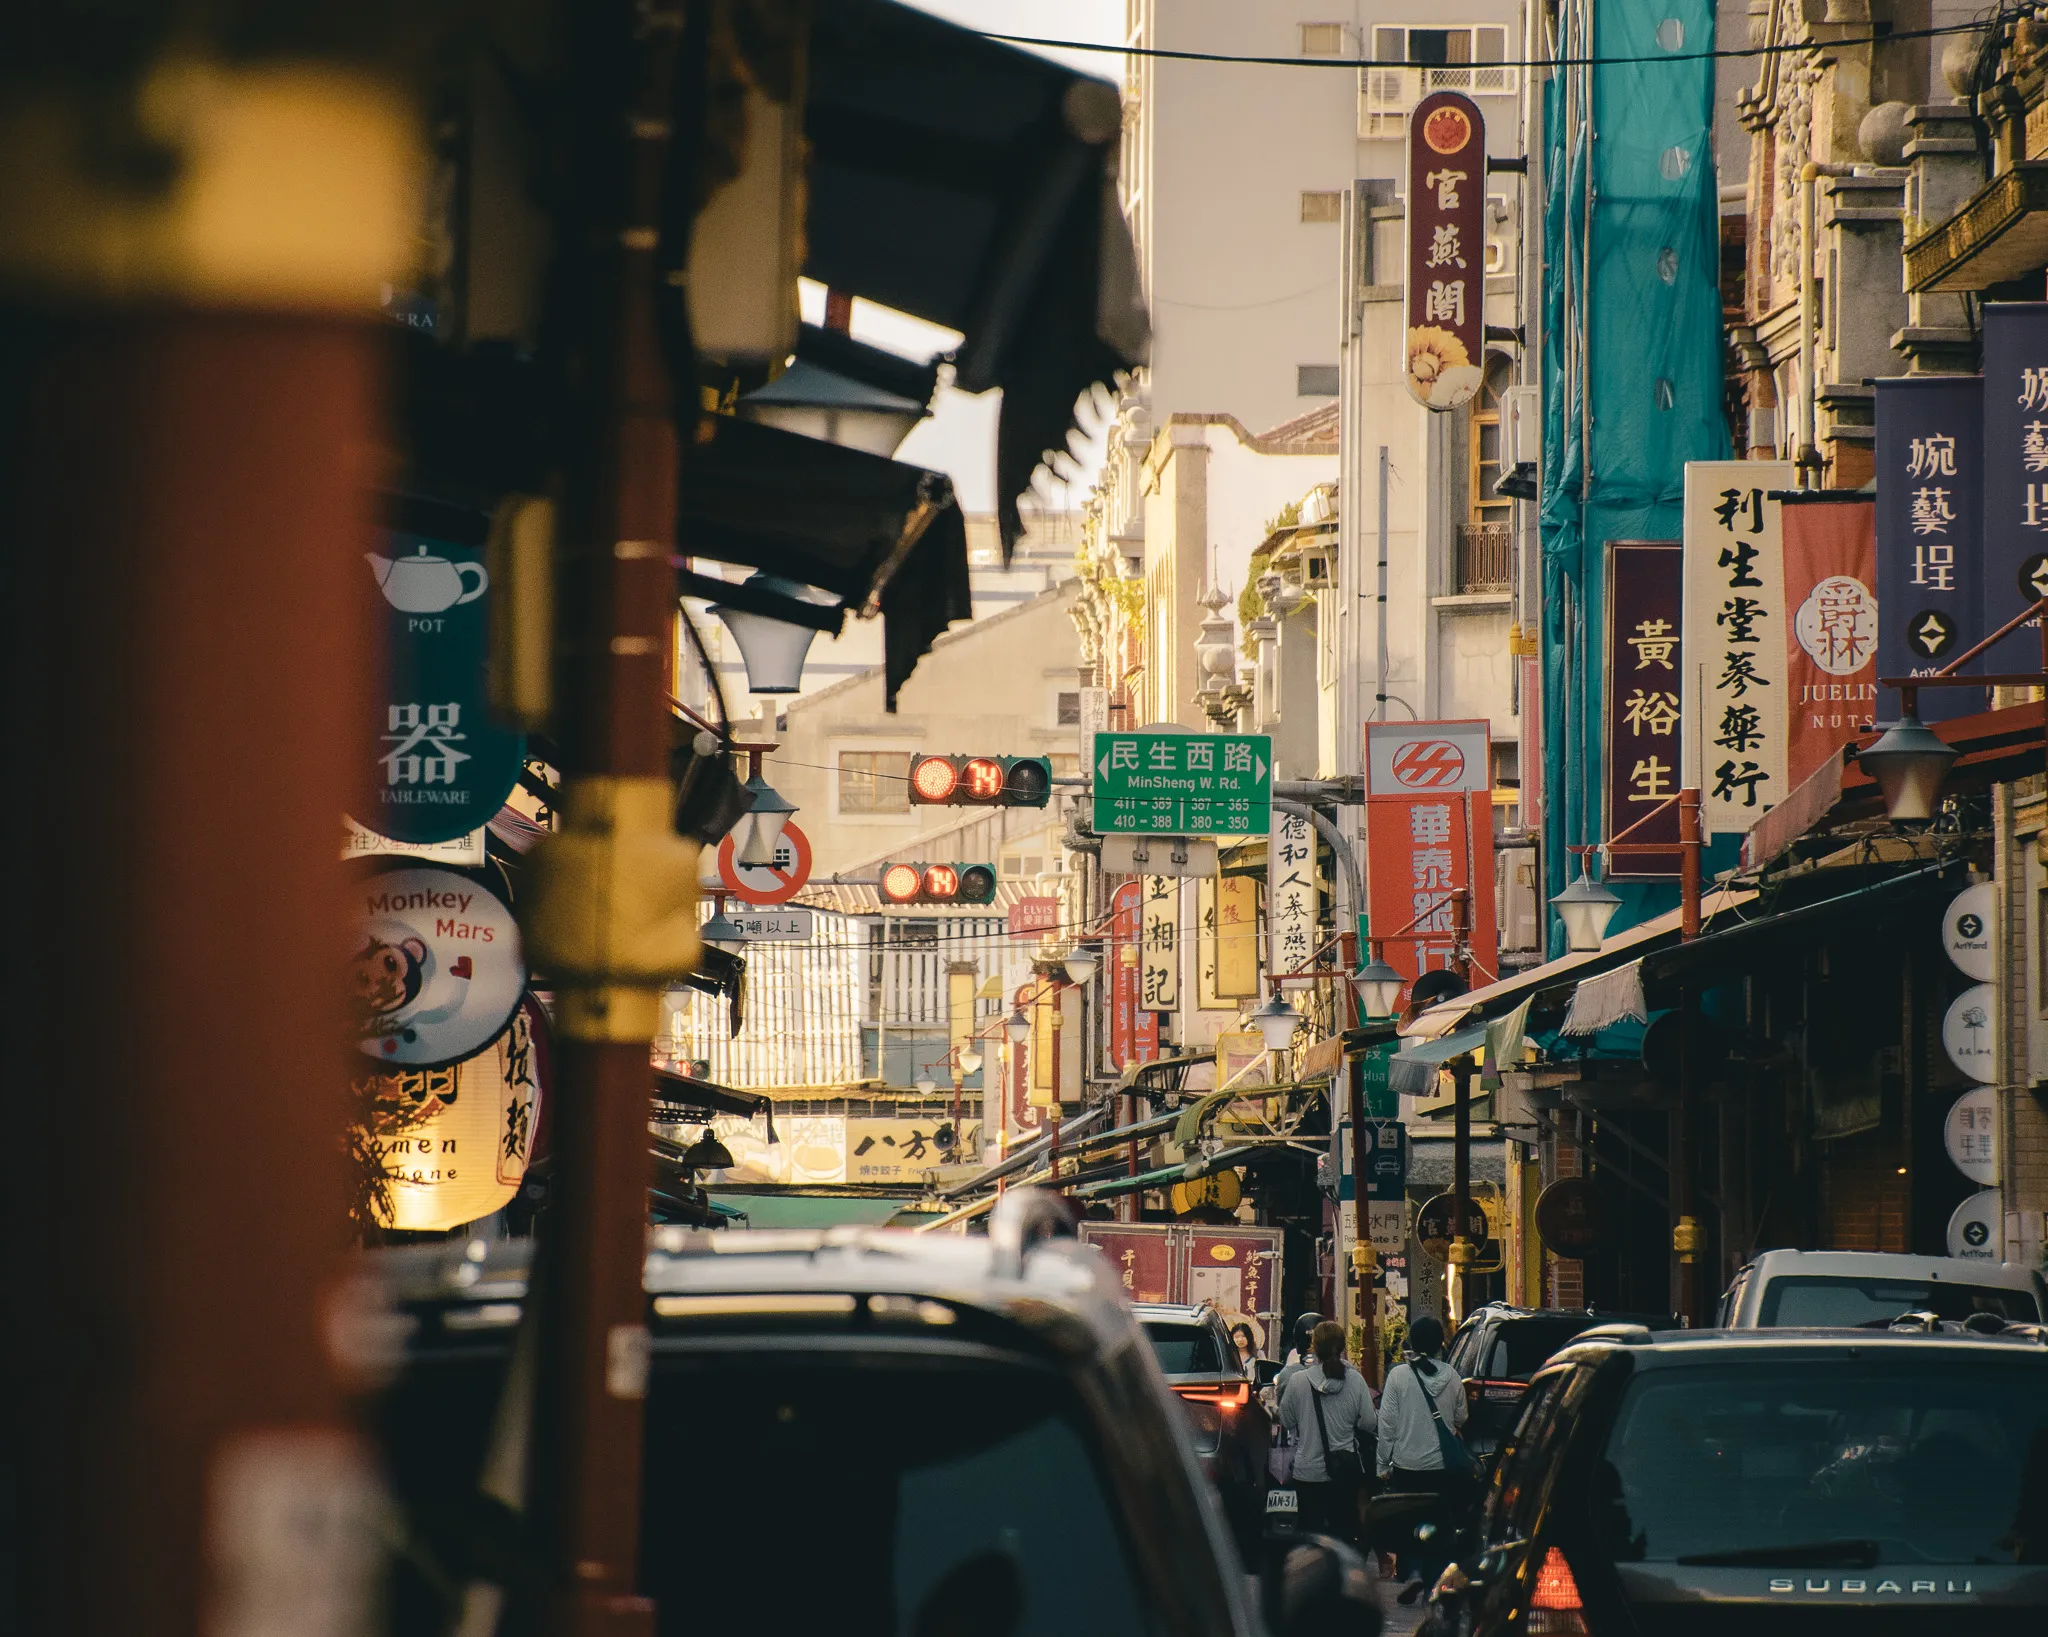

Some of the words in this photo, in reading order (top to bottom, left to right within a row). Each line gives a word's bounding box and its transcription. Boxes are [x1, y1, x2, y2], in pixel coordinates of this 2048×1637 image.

[408, 618, 446, 633] POT
[1622, 618, 1681, 802] 黃裕生
[1812, 714, 1874, 729] NUTS
[378, 702, 472, 786] 器
[1111, 741, 1253, 772] 民生西路
[1128, 776, 1195, 792] MinSheng
[1200, 779, 1214, 789] W.
[1219, 779, 1241, 790] Rd.
[381, 789, 471, 806] TABLEWARE
[1114, 815, 1136, 828] 410
[1151, 816, 1172, 829] 388
[1191, 816, 1212, 829] 380
[1228, 817, 1249, 830] 350
[1410, 803, 1453, 976] 華泰銀行
[366, 888, 473, 915] Monkey
[1023, 905, 1053, 915] ELVIS
[435, 919, 495, 943] Mars
[1953, 941, 1987, 950] ArtYard
[371, 1137, 457, 1154] amen
[1769, 1578, 1972, 1594] SUBARU
